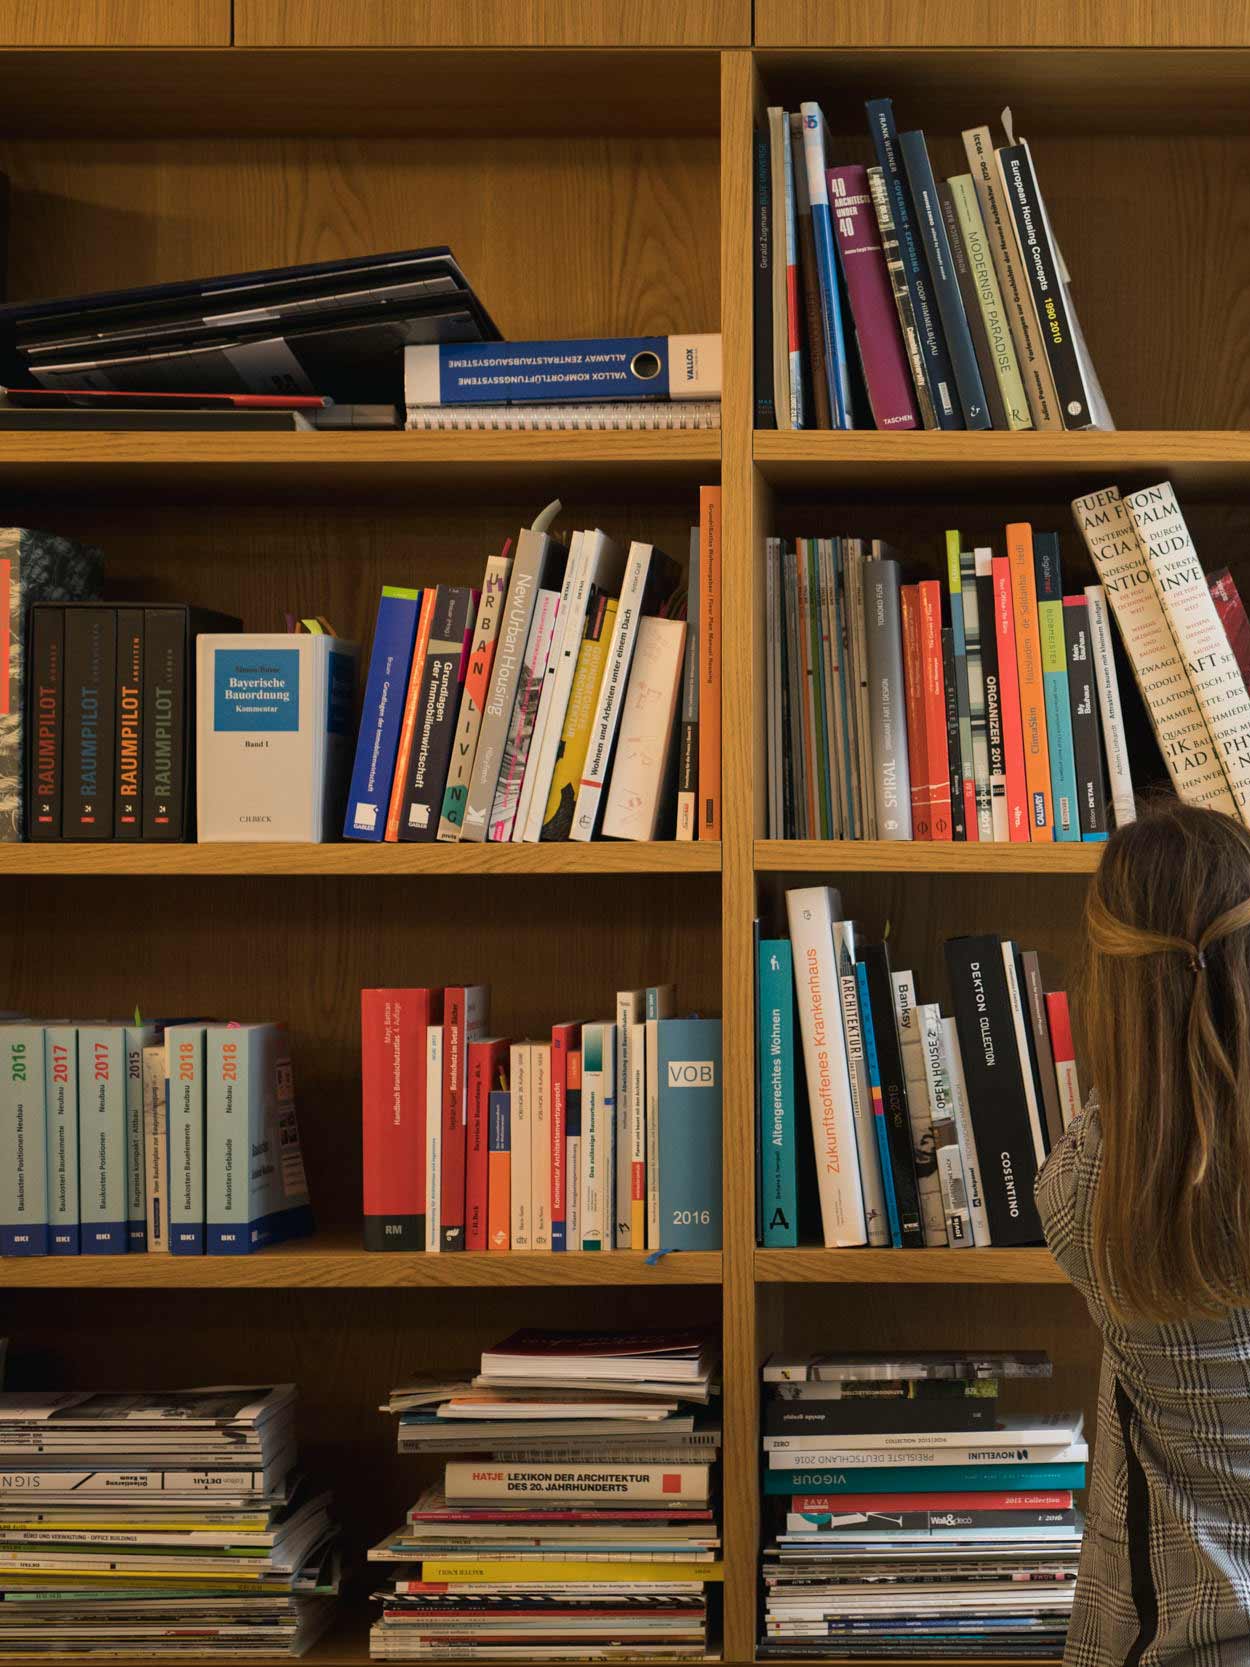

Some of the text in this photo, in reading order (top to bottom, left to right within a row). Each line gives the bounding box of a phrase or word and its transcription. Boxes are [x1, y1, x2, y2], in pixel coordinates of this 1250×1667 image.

[831, 178, 847, 198] 40
[837, 206, 858, 218] UNDER
[839, 217, 854, 237] 40
[1011, 159, 1048, 291] European Housing Concepts
[968, 231, 1010, 373] MODERNIST PARADISE
[1044, 297, 1062, 344] 1990 2010
[449, 354, 626, 367] ALLAWAY ZENTRALSTAUBSAUGSYSTEME
[458, 371, 627, 385] VALLOX KOMFORTLÜFTUNGSSYSTEME
[883, 415, 913, 425] TASCHEN
[1134, 502, 1178, 528] PALM
[1150, 524, 1182, 541] DURCH
[490, 573, 531, 716] New Urban Housing
[1078, 631, 1086, 661] Bauhaus
[224, 690, 290, 702] Bauordnung
[229, 677, 285, 689] Bayerische
[435, 662, 453, 722] Grundlagen
[591, 609, 632, 777] Wohnen und Arbeiten unter einem Dach
[235, 705, 278, 713] Kommentar
[415, 660, 441, 788] der Immobilienwirtschaft
[987, 676, 1002, 776] ORGANIZER 2018
[1077, 703, 1085, 715] My
[38, 686, 57, 796] RAUMPILOT
[80, 687, 98, 796] RAUMPILOT
[121, 686, 139, 796] RAUMPILOT
[155, 687, 172, 796] RAUMPILOT
[245, 740, 262, 748] Band
[1031, 707, 1039, 754] ClimaSkin
[885, 759, 898, 808] SPIRAL
[1088, 782, 1096, 807] DETAIL
[1036, 793, 1045, 826] CALLWEY
[898, 984, 911, 1029] Banksy
[971, 962, 996, 1066] DEKTON COLLECTION
[12, 1044, 27, 1081] 2016
[53, 1045, 68, 1083] 2017
[95, 1043, 109, 1080] 2017
[129, 1051, 141, 1079] 2015
[179, 1043, 194, 1080] 2018
[222, 1043, 237, 1081] 2018
[670, 1065, 713, 1082] VOB
[770, 1008, 783, 1146] Altengerechtes Wohnen
[807, 948, 841, 1175] Zukunftsoffenes Krankenhaus
[927, 1041, 945, 1110] OPEN HOUSE
[554, 1082, 562, 1172] Architektenvertragsrecht
[1001, 1152, 1019, 1218] COSENTINO
[385, 1225, 402, 1235] RM
[673, 1210, 710, 1225] 2016
[952, 1216, 960, 1240] jovis
[795, 1454, 934, 1465] PREISLISTE DEUTSCHLAND 2016
[968, 1451, 1015, 1460] NOVELLINI
[508, 1473, 551, 1481] LEXIKON
[577, 1474, 650, 1482] ARCHITEKTUR
[530, 1483, 544, 1491] 20.
[793, 1473, 846, 1485] VIGOUR
